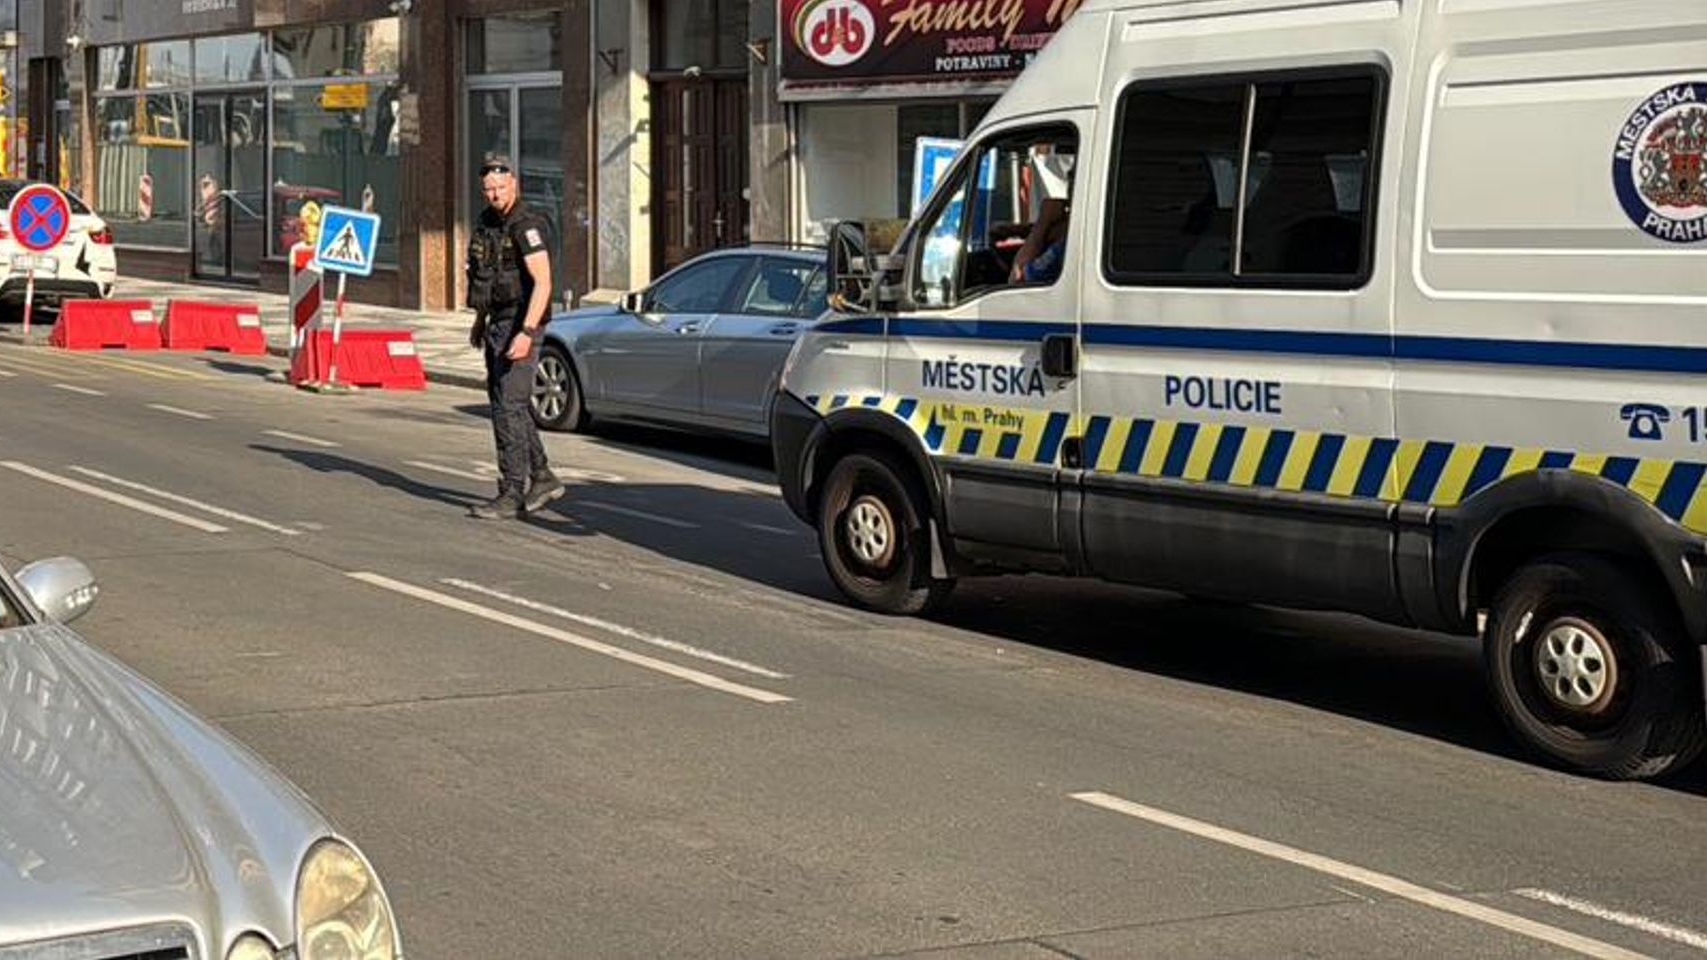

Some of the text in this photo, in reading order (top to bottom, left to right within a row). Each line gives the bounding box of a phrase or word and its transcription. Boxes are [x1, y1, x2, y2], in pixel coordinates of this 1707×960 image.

[935, 54, 1011, 71] POTRAVINY
[1643, 212, 1707, 241] PRAH
[921, 354, 1046, 397] MĚSTSKÁ
[1165, 375, 1282, 414] POLICIE
[984, 407, 1025, 430] Prahy
